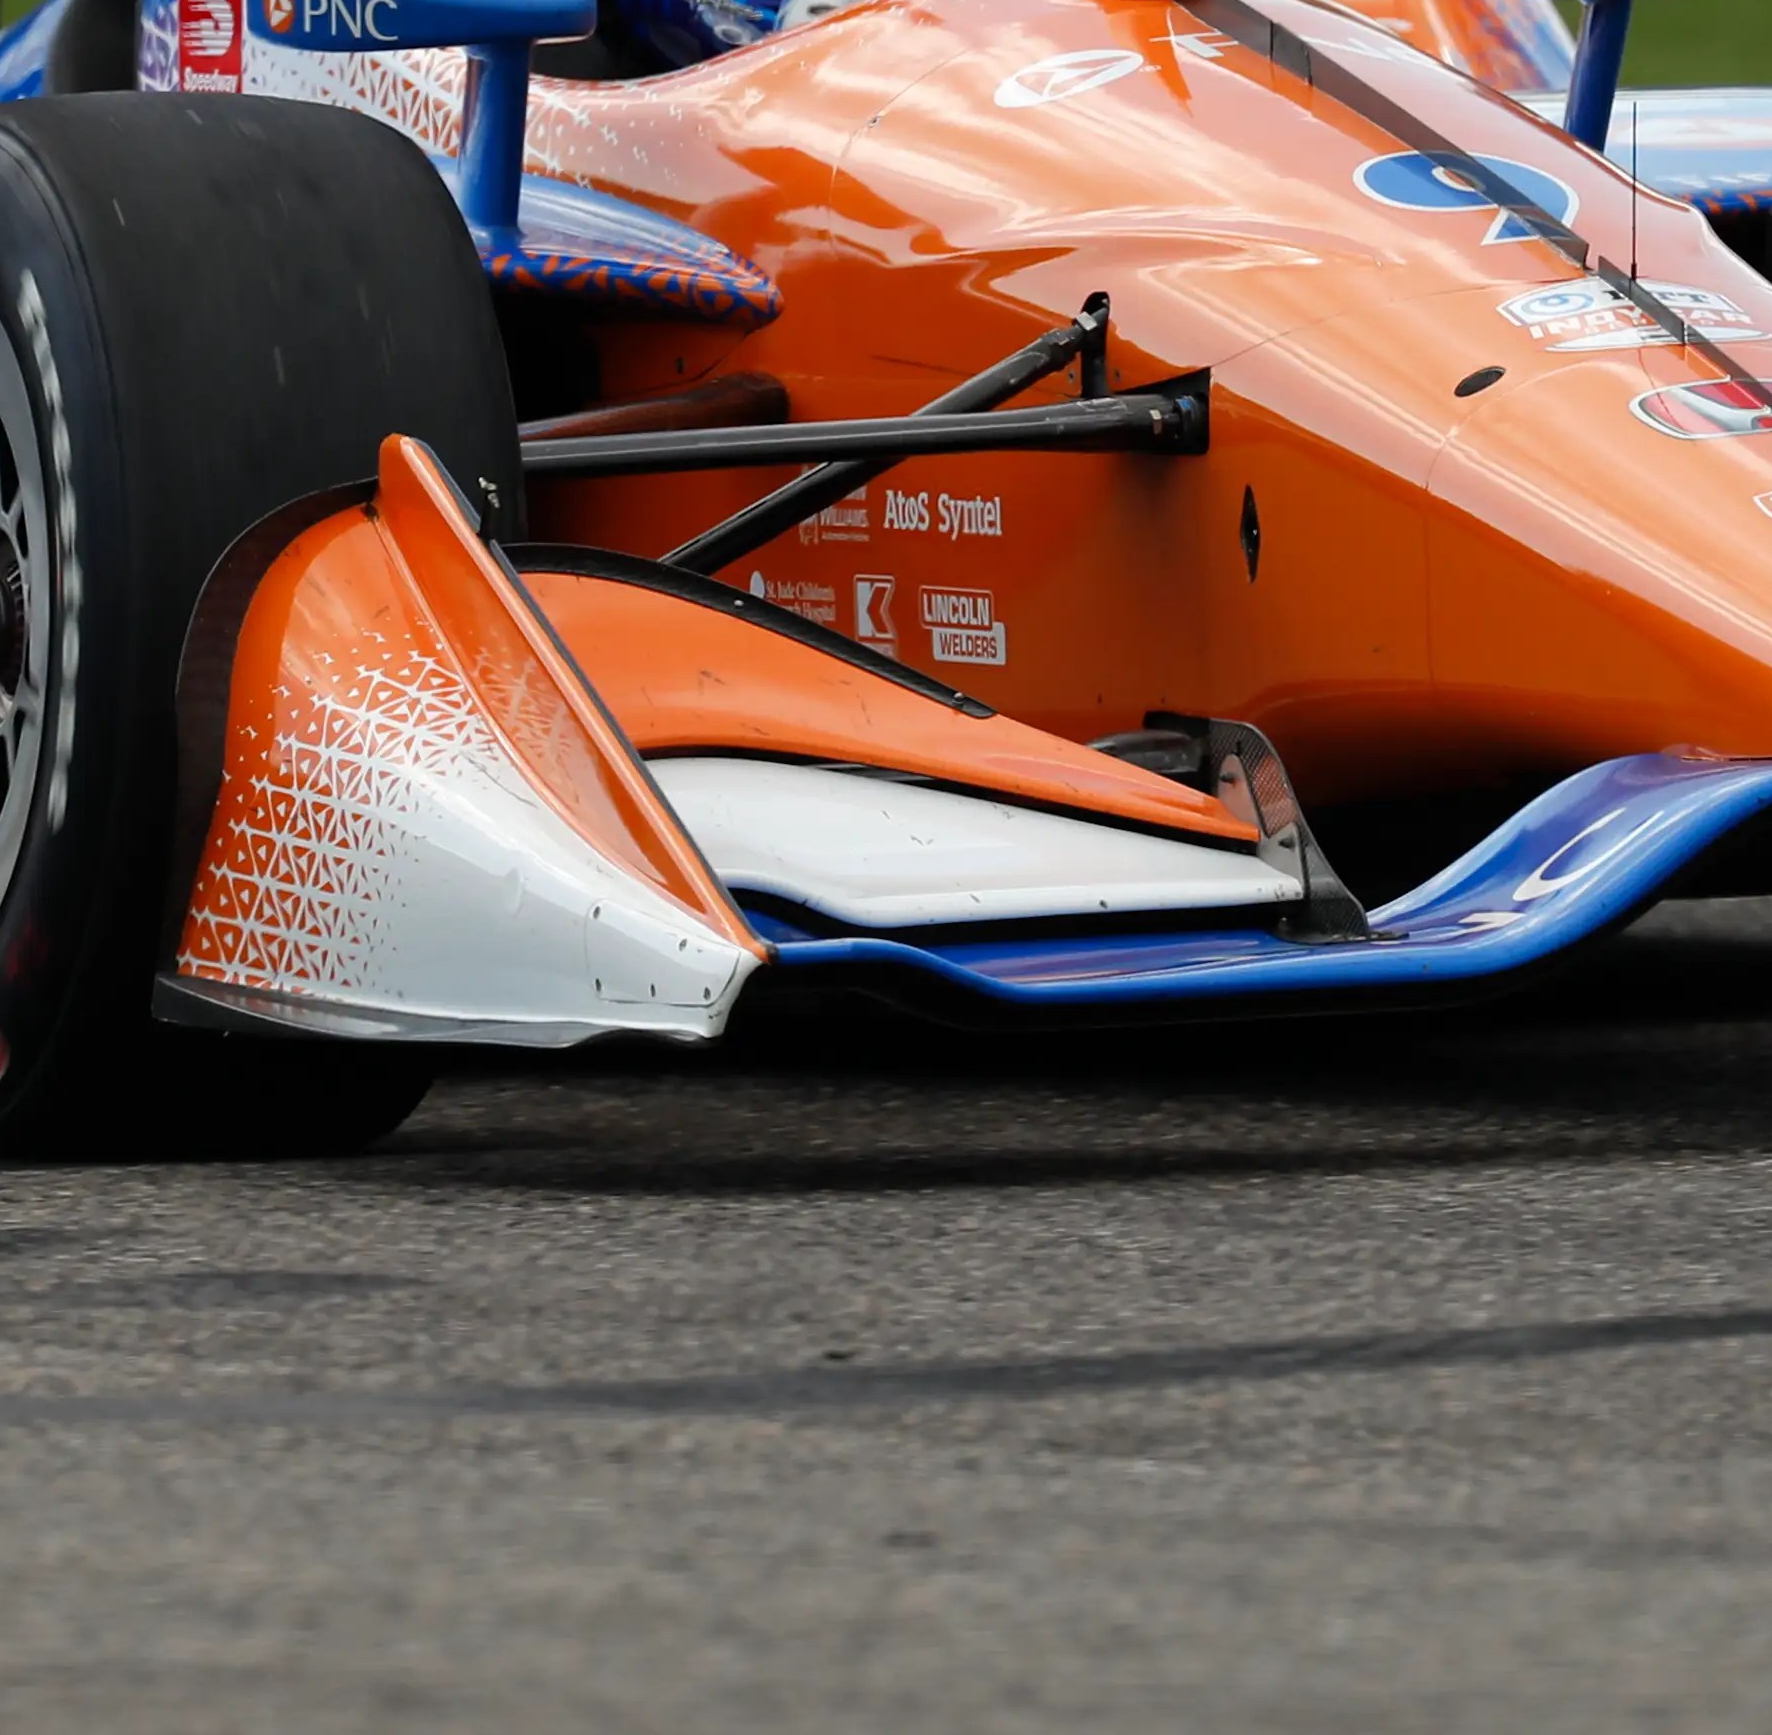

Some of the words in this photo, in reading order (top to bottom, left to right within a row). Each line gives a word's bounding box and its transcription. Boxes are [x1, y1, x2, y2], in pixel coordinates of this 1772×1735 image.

[183, 66, 239, 94] Speedway
[1352, 149, 1580, 246] 9
[937, 492, 1002, 541] Syntel
[923, 593, 990, 626] LINCOLN
[939, 632, 998, 659] WELDERS
